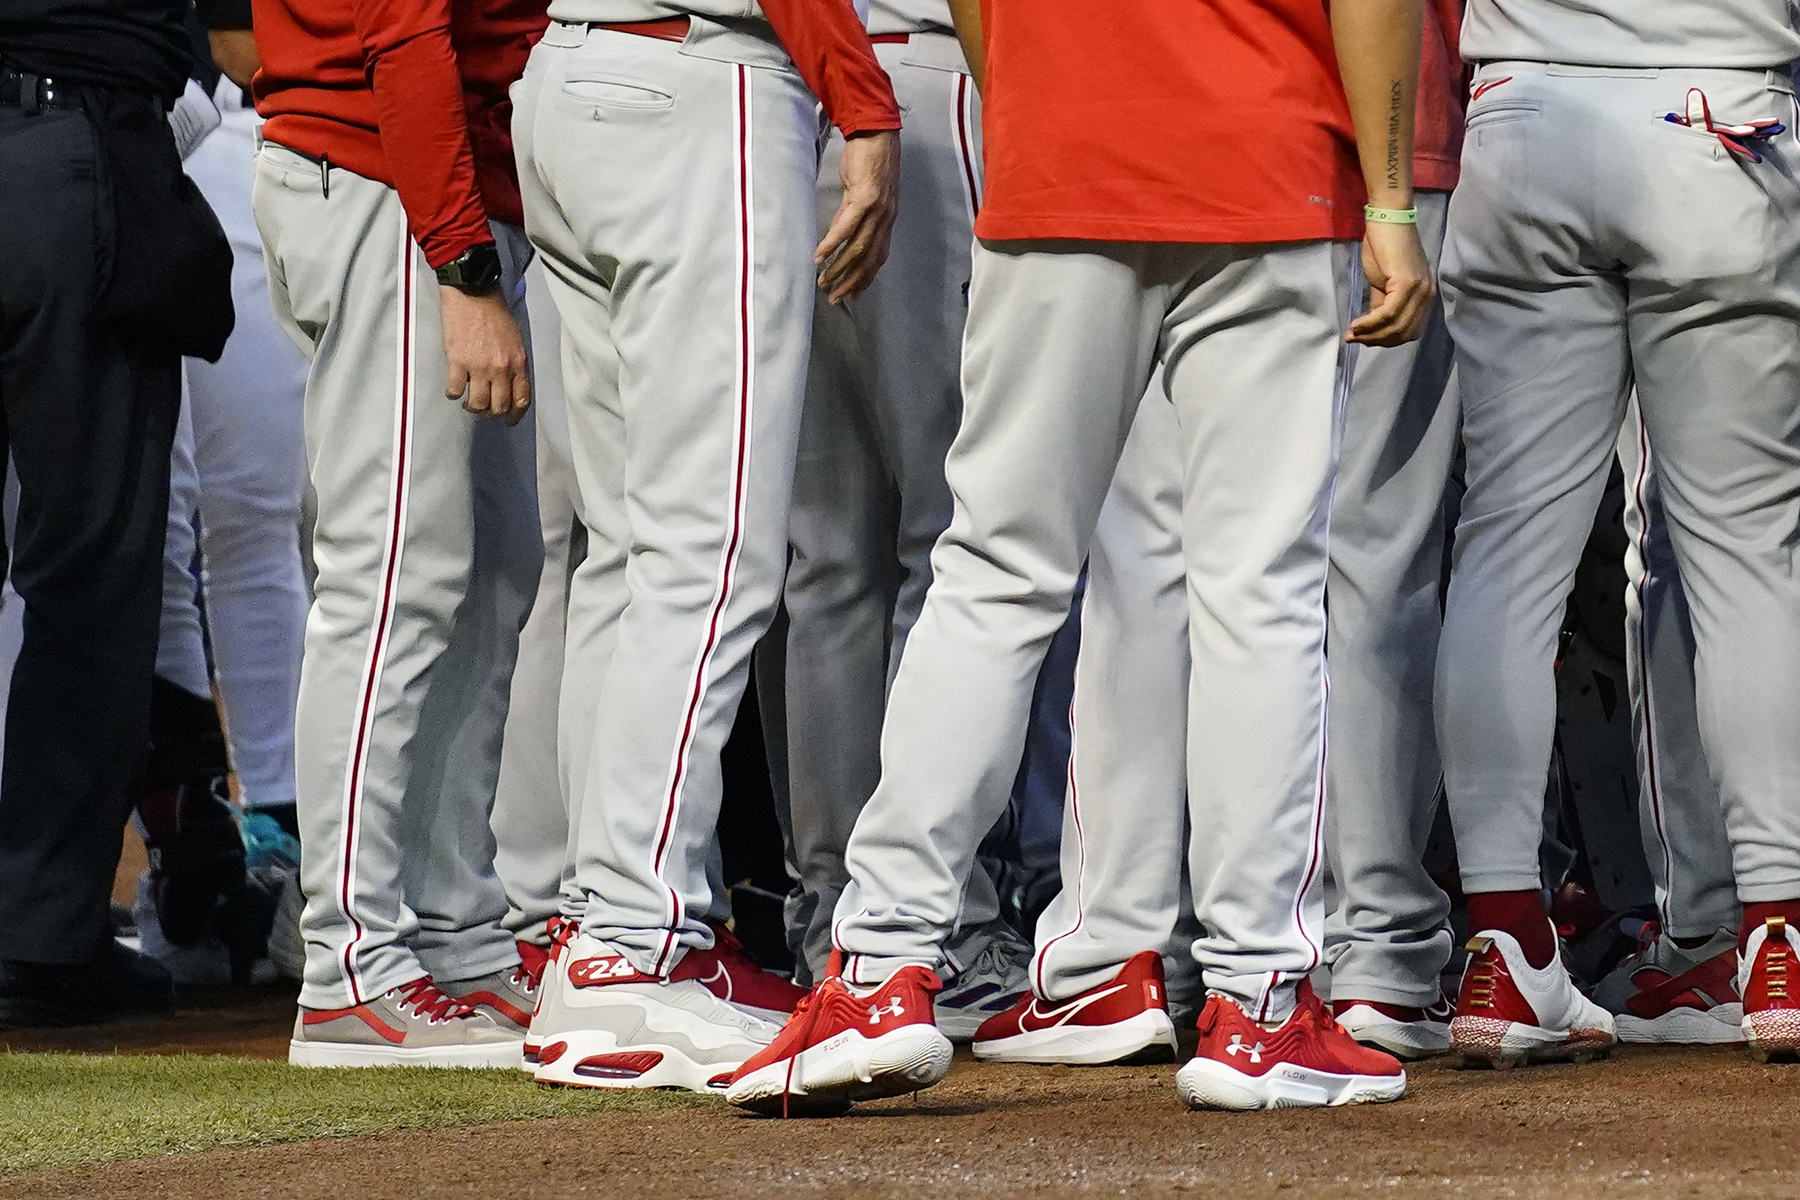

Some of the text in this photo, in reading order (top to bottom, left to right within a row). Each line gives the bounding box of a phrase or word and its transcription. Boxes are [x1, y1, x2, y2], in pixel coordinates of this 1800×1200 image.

[587, 957, 635, 980] 24
[823, 1035, 850, 1054] FLOW
[1281, 1069, 1309, 1081] FLOW
